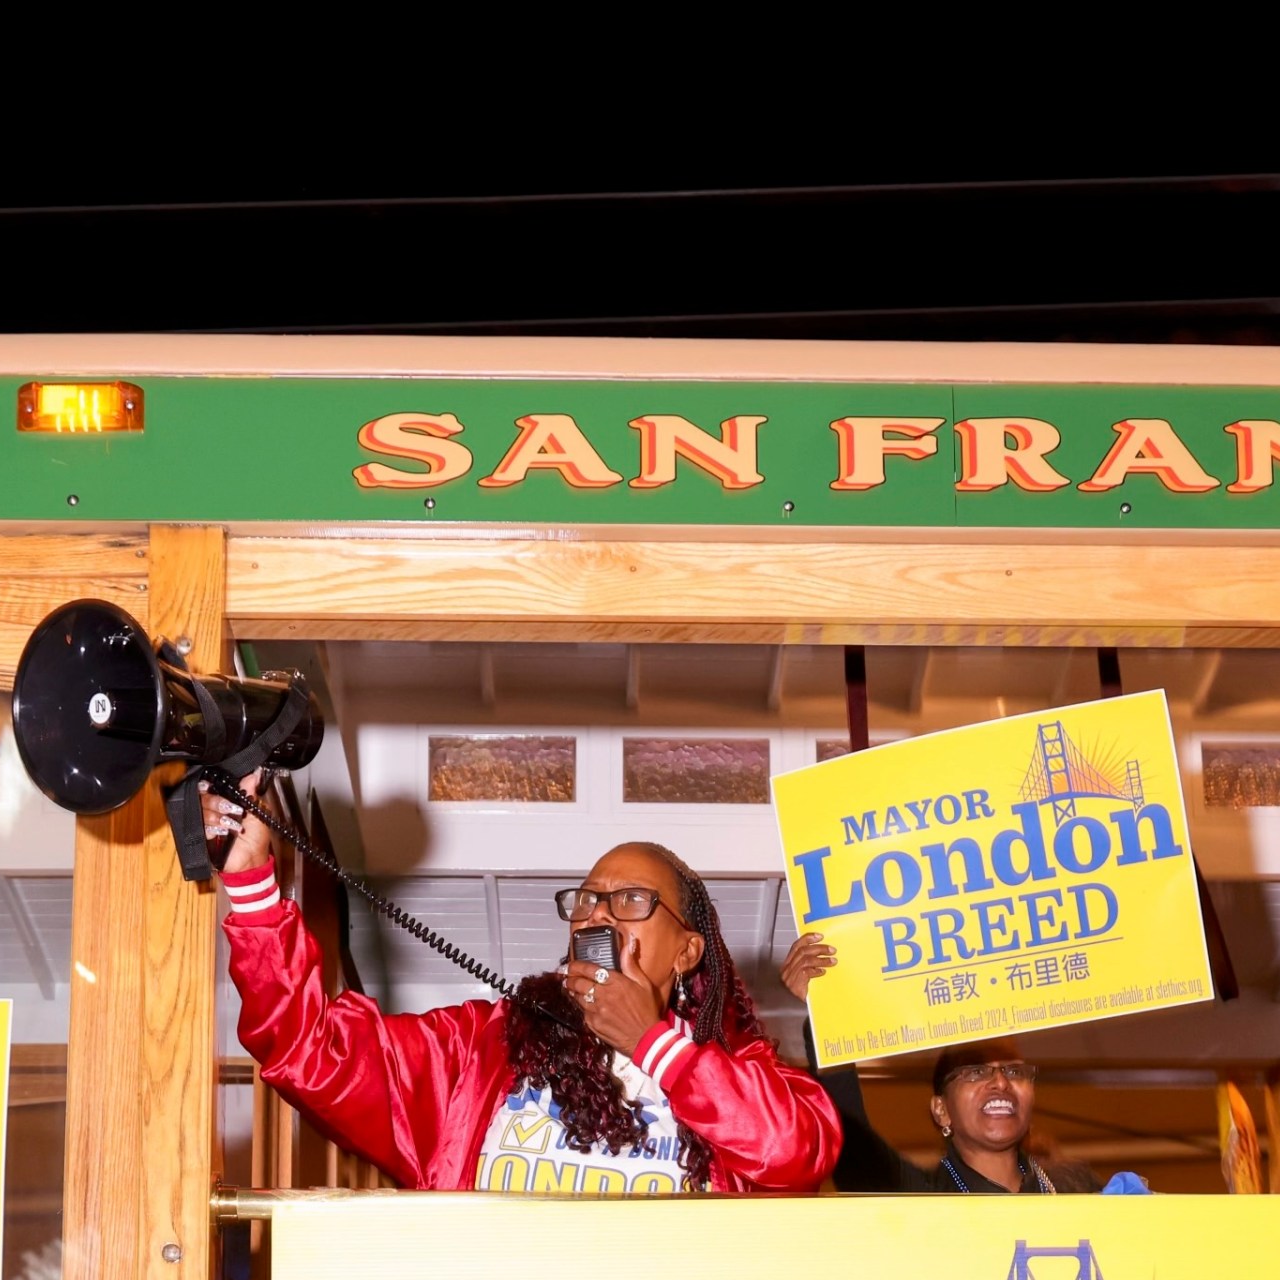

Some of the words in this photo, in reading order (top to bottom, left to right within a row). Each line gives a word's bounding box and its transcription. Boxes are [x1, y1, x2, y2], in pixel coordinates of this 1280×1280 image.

[352, 411, 768, 491] SAN
[841, 788, 995, 846] MAYOR
[793, 799, 1184, 925] London
[874, 882, 1120, 975] BREED
[824, 1038, 843, 1058] Paid
[843, 1038, 855, 1055] for
[856, 1036, 866, 1056] by
[902, 1024, 928, 1047] Mayor
[929, 1020, 958, 1039] London
[960, 1011, 984, 1034] Breed
[1011, 1003, 1048, 1024] Financial
[1049, 997, 1093, 1019] disclosures
[1094, 995, 1107, 1010] are
[1110, 985, 1143, 1008] available
[1146, 987, 1154, 1002] at
